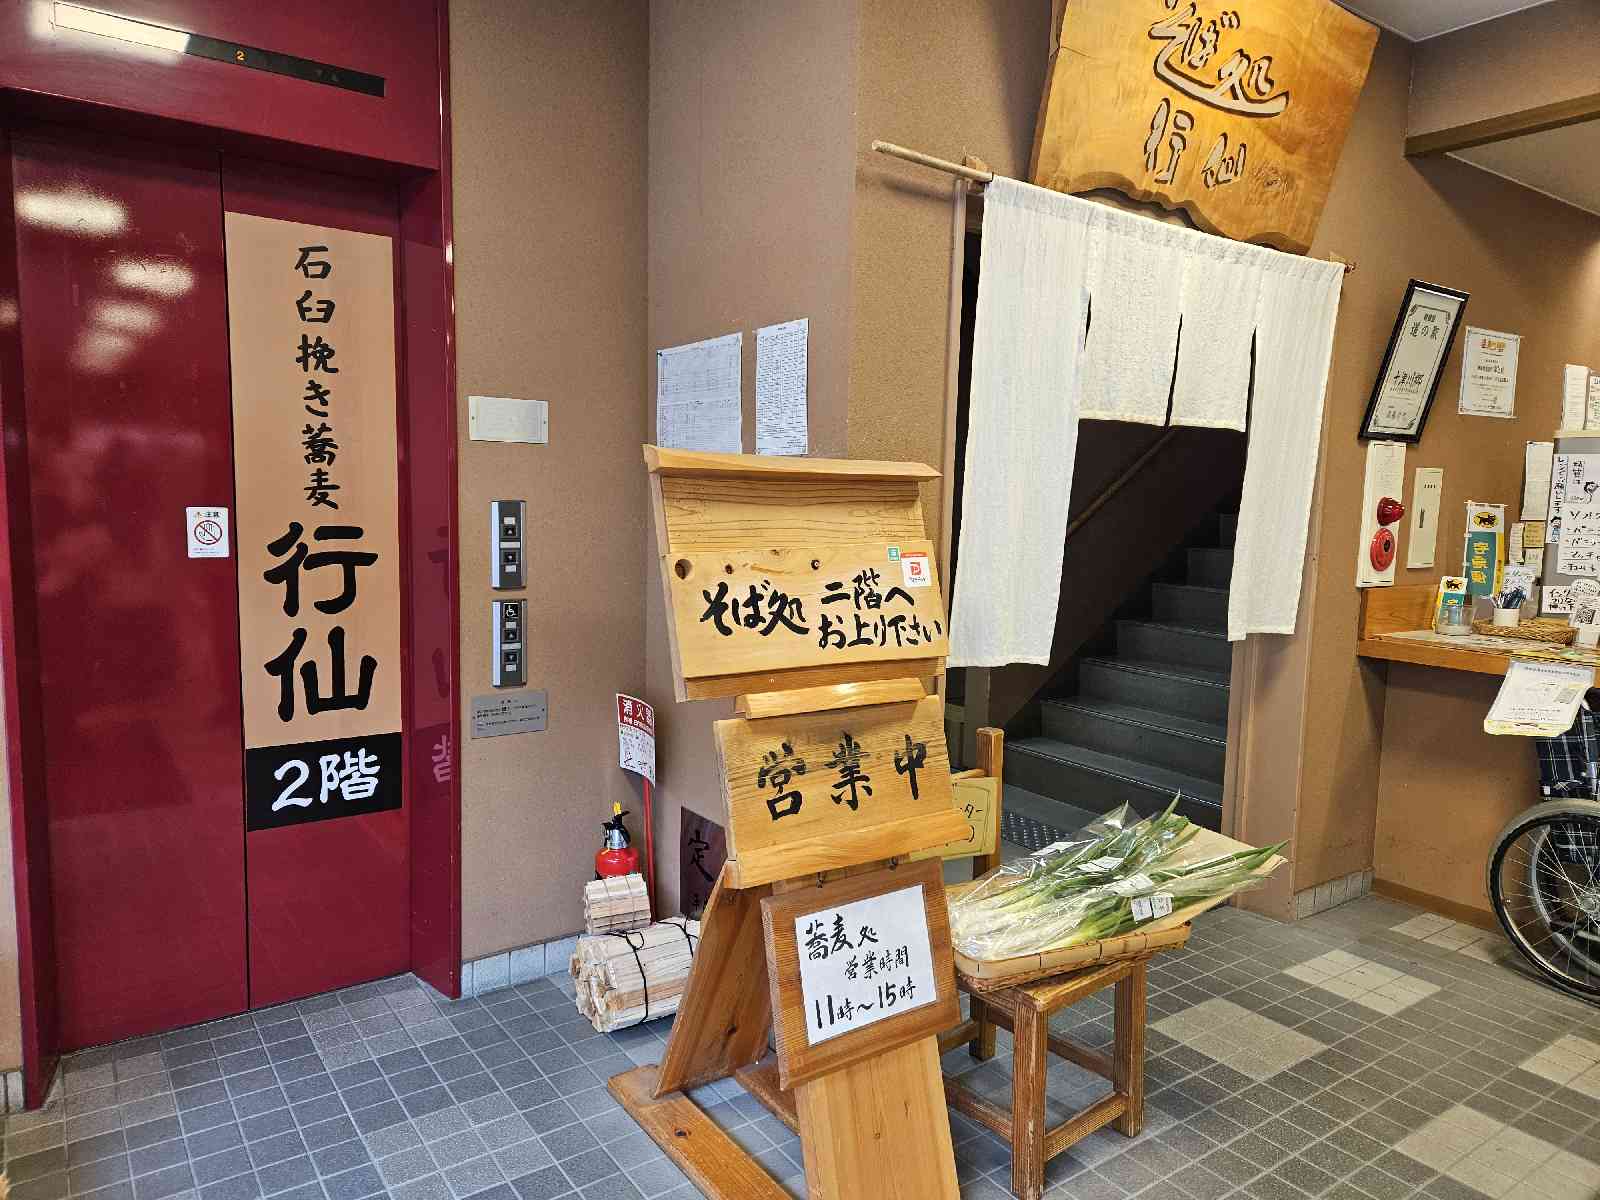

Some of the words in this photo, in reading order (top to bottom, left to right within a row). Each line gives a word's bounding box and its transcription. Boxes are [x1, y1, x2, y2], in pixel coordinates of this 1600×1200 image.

[236, 50, 245, 61] 2
[294, 244, 340, 510] 石臼挽き蕎麦
[699, 579, 810, 637] そば処
[820, 568, 915, 610] 二階へ
[263, 520, 380, 724] 行仙
[818, 613, 943, 650] お上り下さい
[271, 748, 382, 812] 2階
[757, 730, 928, 821] 営業中
[805, 913, 879, 961] 蕎麦処
[845, 945, 909, 980] 営業時間
